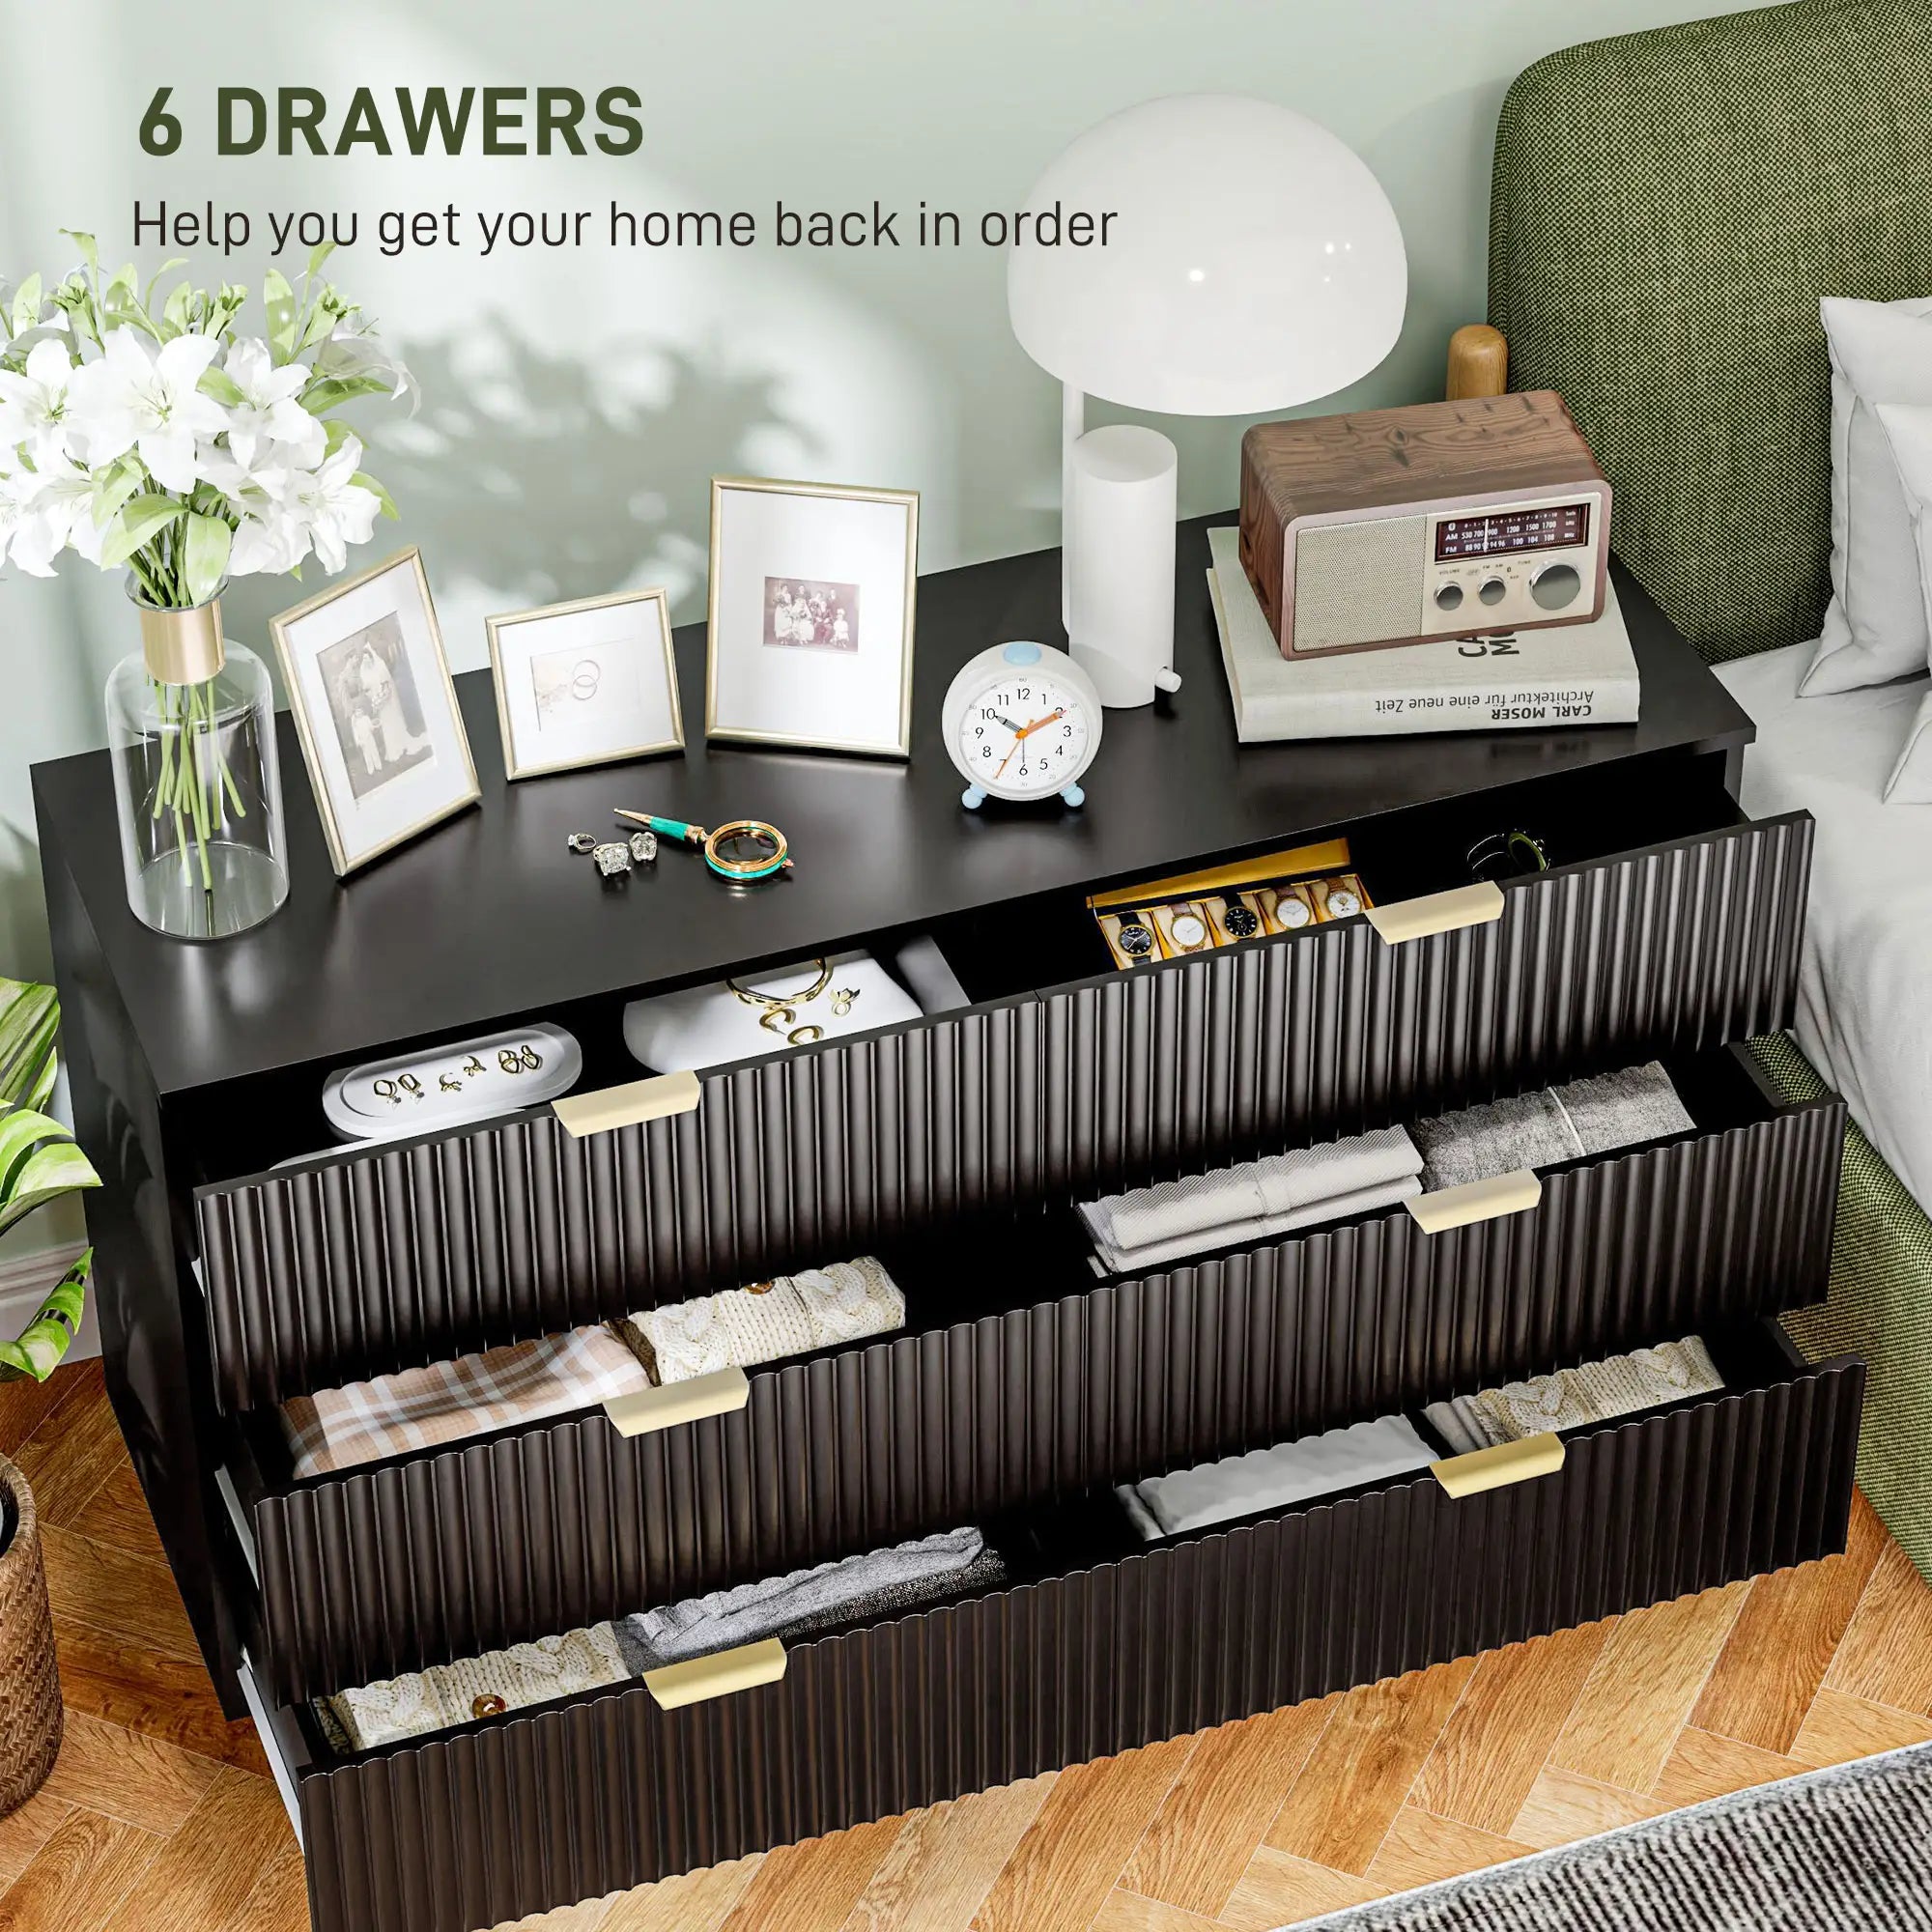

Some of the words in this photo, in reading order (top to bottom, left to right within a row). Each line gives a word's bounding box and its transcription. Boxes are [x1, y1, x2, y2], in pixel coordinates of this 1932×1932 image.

[1462, 531, 1473, 540] 530
[1526, 523, 1539, 531] 1500
[1543, 521, 1556, 529] 1700
[997, 694, 1009, 706] 11
[1017, 688, 1031, 700] 12
[1041, 693, 1046, 705] 1
[1485, 694, 1506, 707] für
[1511, 690, 1594, 705] Architektur
[1375, 699, 1404, 714] Zeit
[1408, 697, 1444, 709] neue
[1449, 696, 1480, 709] eine
[980, 707, 996, 721] 10
[1491, 706, 1546, 721] MOSER
[1552, 704, 1592, 718] CARL
[975, 726, 984, 740] 9
[1063, 724, 1071, 737] 3
[982, 745, 992, 758] 8
[1055, 744, 1063, 756] 4
[1018, 763, 1028, 776] 6
[1039, 757, 1048, 771] 5
